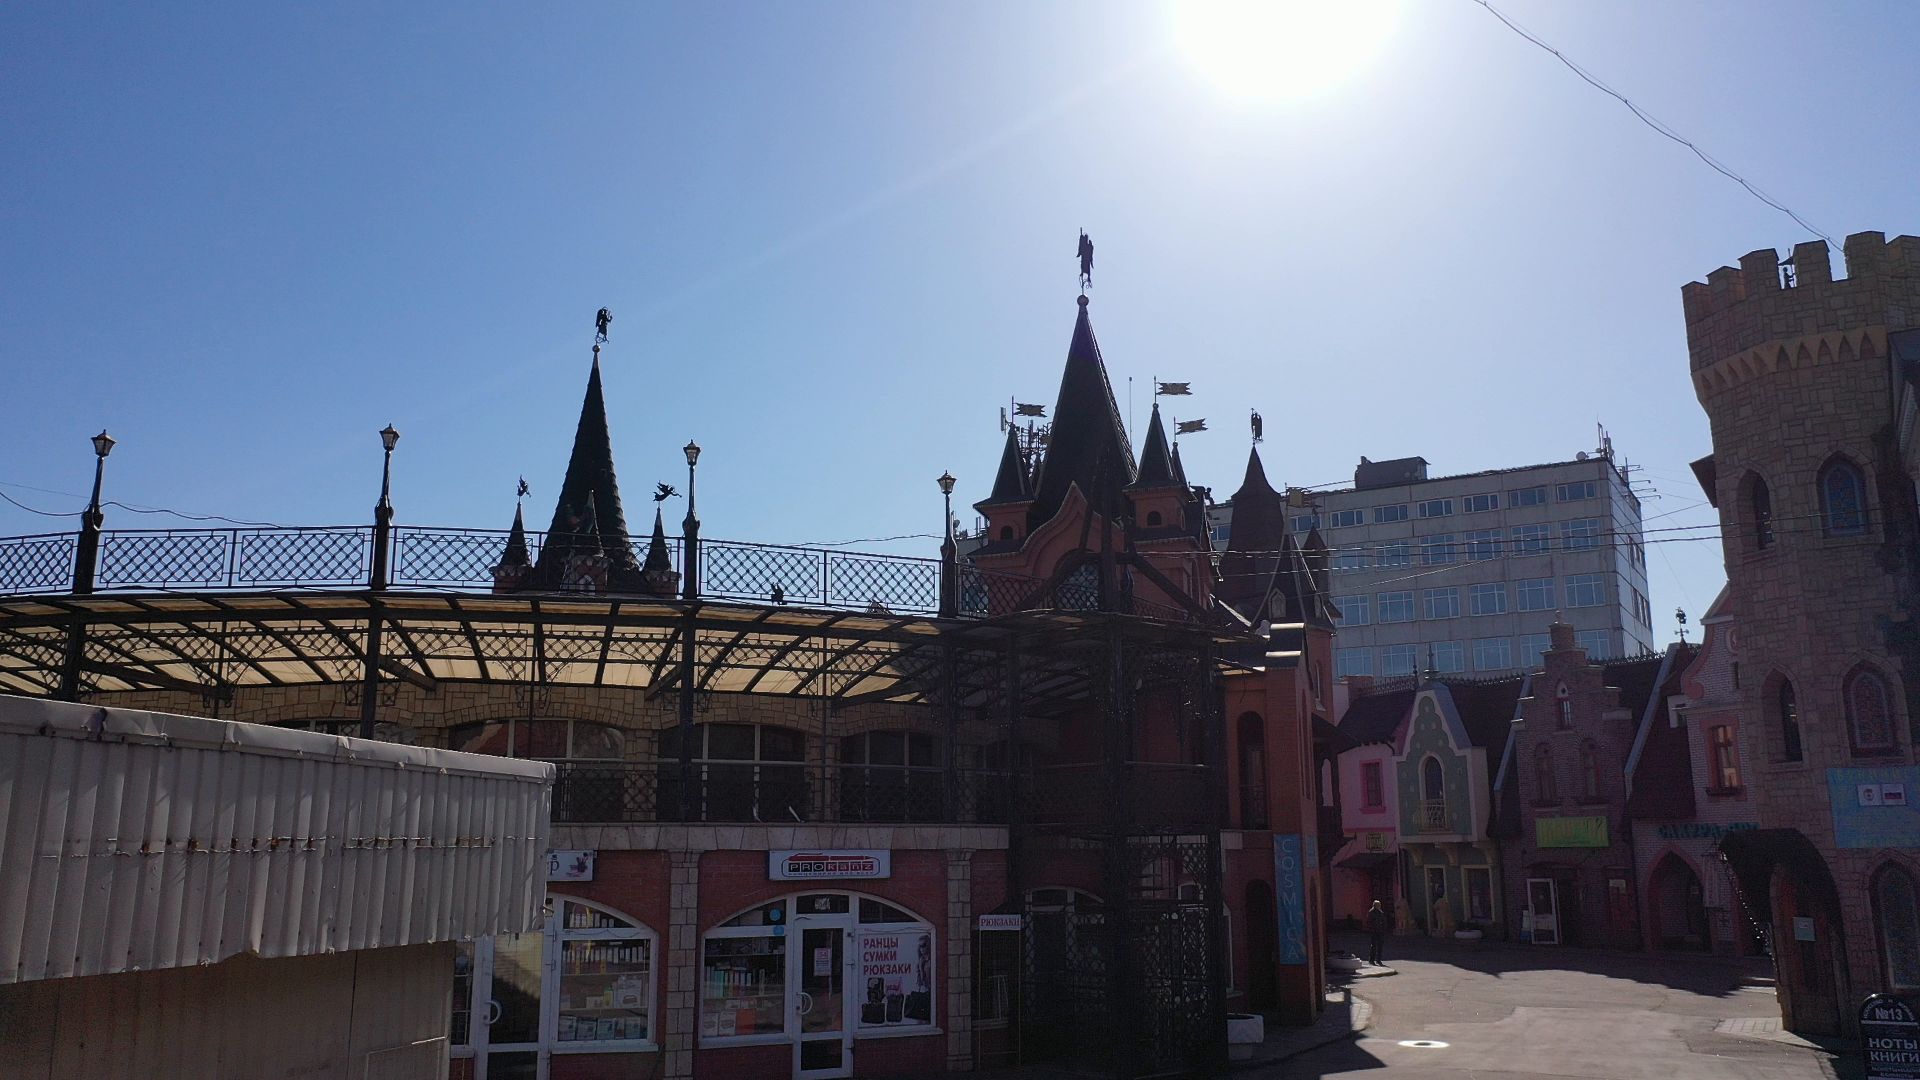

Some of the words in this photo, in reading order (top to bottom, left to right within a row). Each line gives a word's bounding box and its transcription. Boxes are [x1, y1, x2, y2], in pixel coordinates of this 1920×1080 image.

[1281, 838, 1299, 960] COSMICA
[981, 918, 1020, 927] РЮКЗАКИ
[863, 937, 899, 949] РАНЦЫ
[863, 951, 897, 962] СУМКИ
[863, 964, 912, 975] РЮКЗАКИ
[1875, 1007, 1903, 1020] №13
[1868, 1037, 1918, 1049] НОТЫ
[1870, 1051, 1920, 1063] КНИГИ
